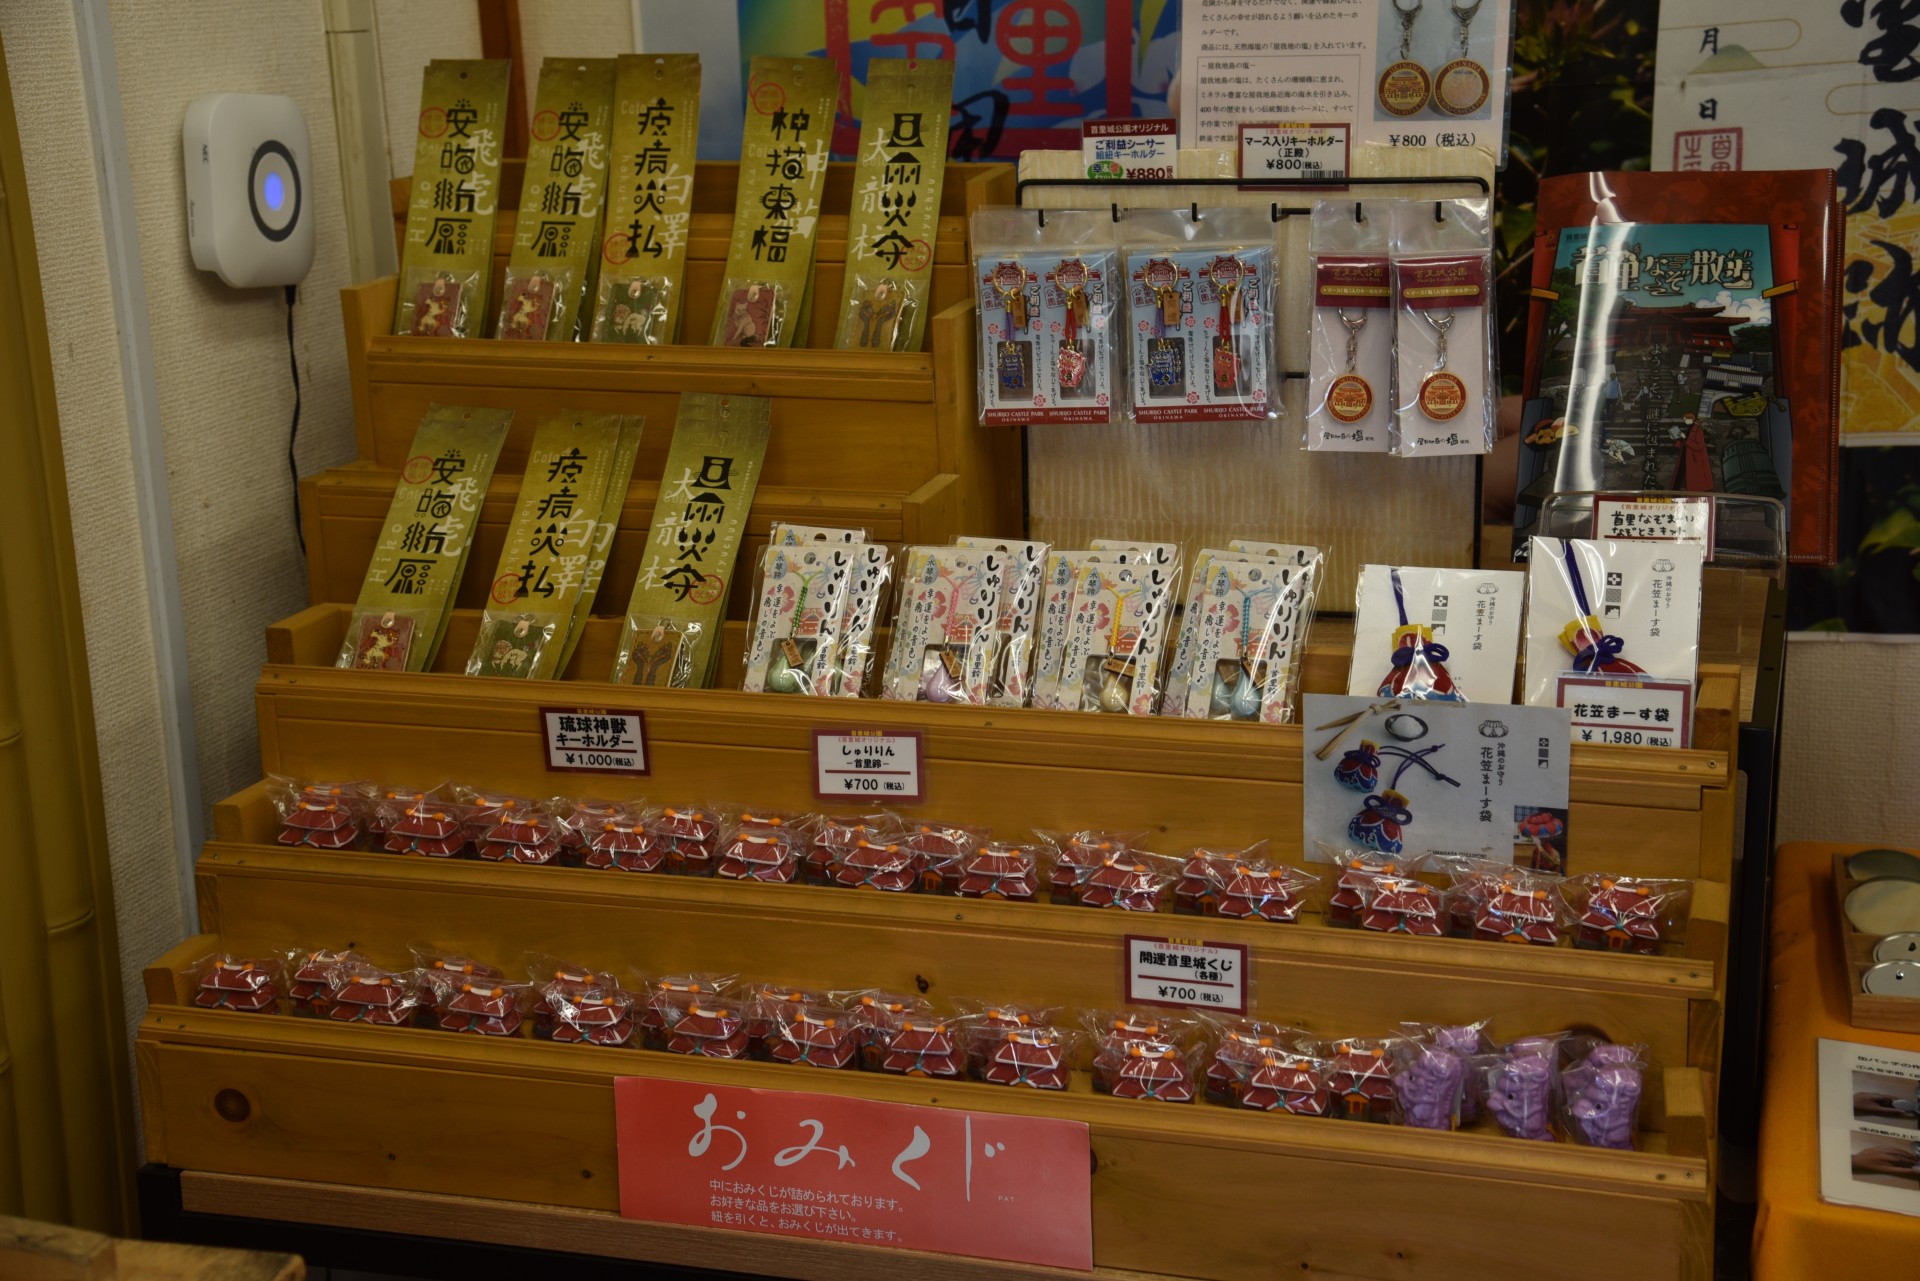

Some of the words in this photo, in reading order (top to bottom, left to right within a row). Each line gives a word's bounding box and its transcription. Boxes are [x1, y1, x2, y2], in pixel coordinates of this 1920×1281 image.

[1700, 27, 1720, 55] 月
[1699, 98, 1719, 121] 日
[1090, 123, 1169, 135] 首里城公園オリジナル
[1095, 138, 1165, 150] ご利益シーサー
[1244, 136, 1344, 147] マース入りキーホルダー
[1389, 134, 1427, 147] ¥800
[1435, 132, 1476, 147] (税込)
[1096, 149, 1165, 160] 組紐キーホルダー
[1278, 148, 1310, 158] (正殿)
[1266, 159, 1302, 170] ¥800
[1126, 167, 1165, 179] ¥880
[1332, 267, 1384, 277] 首里城公園
[1415, 267, 1467, 278] 首里城公園
[1664, 575, 1673, 609] 沖縄のお守り
[1649, 579, 1664, 638] 花笠まーす袋
[1472, 600, 1487, 652] 花笠まーす袋
[1574, 703, 1670, 723] 花笠まーす袋
[558, 716, 628, 735] 琉球神獣
[556, 733, 635, 749] キーホルダー
[1646, 736, 1672, 748] (税込)
[842, 745, 896, 757] しゅりりん
[613, 757, 636, 768] (税込)
[1496, 741, 1507, 787] 沖縄のお守り
[844, 778, 879, 791] ¥700
[883, 781, 905, 791] (税込)
[1479, 746, 1494, 824] 花笠まーす袋
[1139, 950, 1233, 972] 開運首里城くじ
[1194, 970, 1223, 983] (各種)
[1158, 985, 1197, 1001] ¥700
[1199, 992, 1224, 1004] (税込)
[687, 1091, 1007, 1202] おみくじ
[709, 1178, 905, 1214] 中におみくじが詰められております。
[710, 1193, 858, 1225] お好きな品をお選び下さい。
[711, 1210, 904, 1243] 紐を引くと、おみくじが出てきます。
